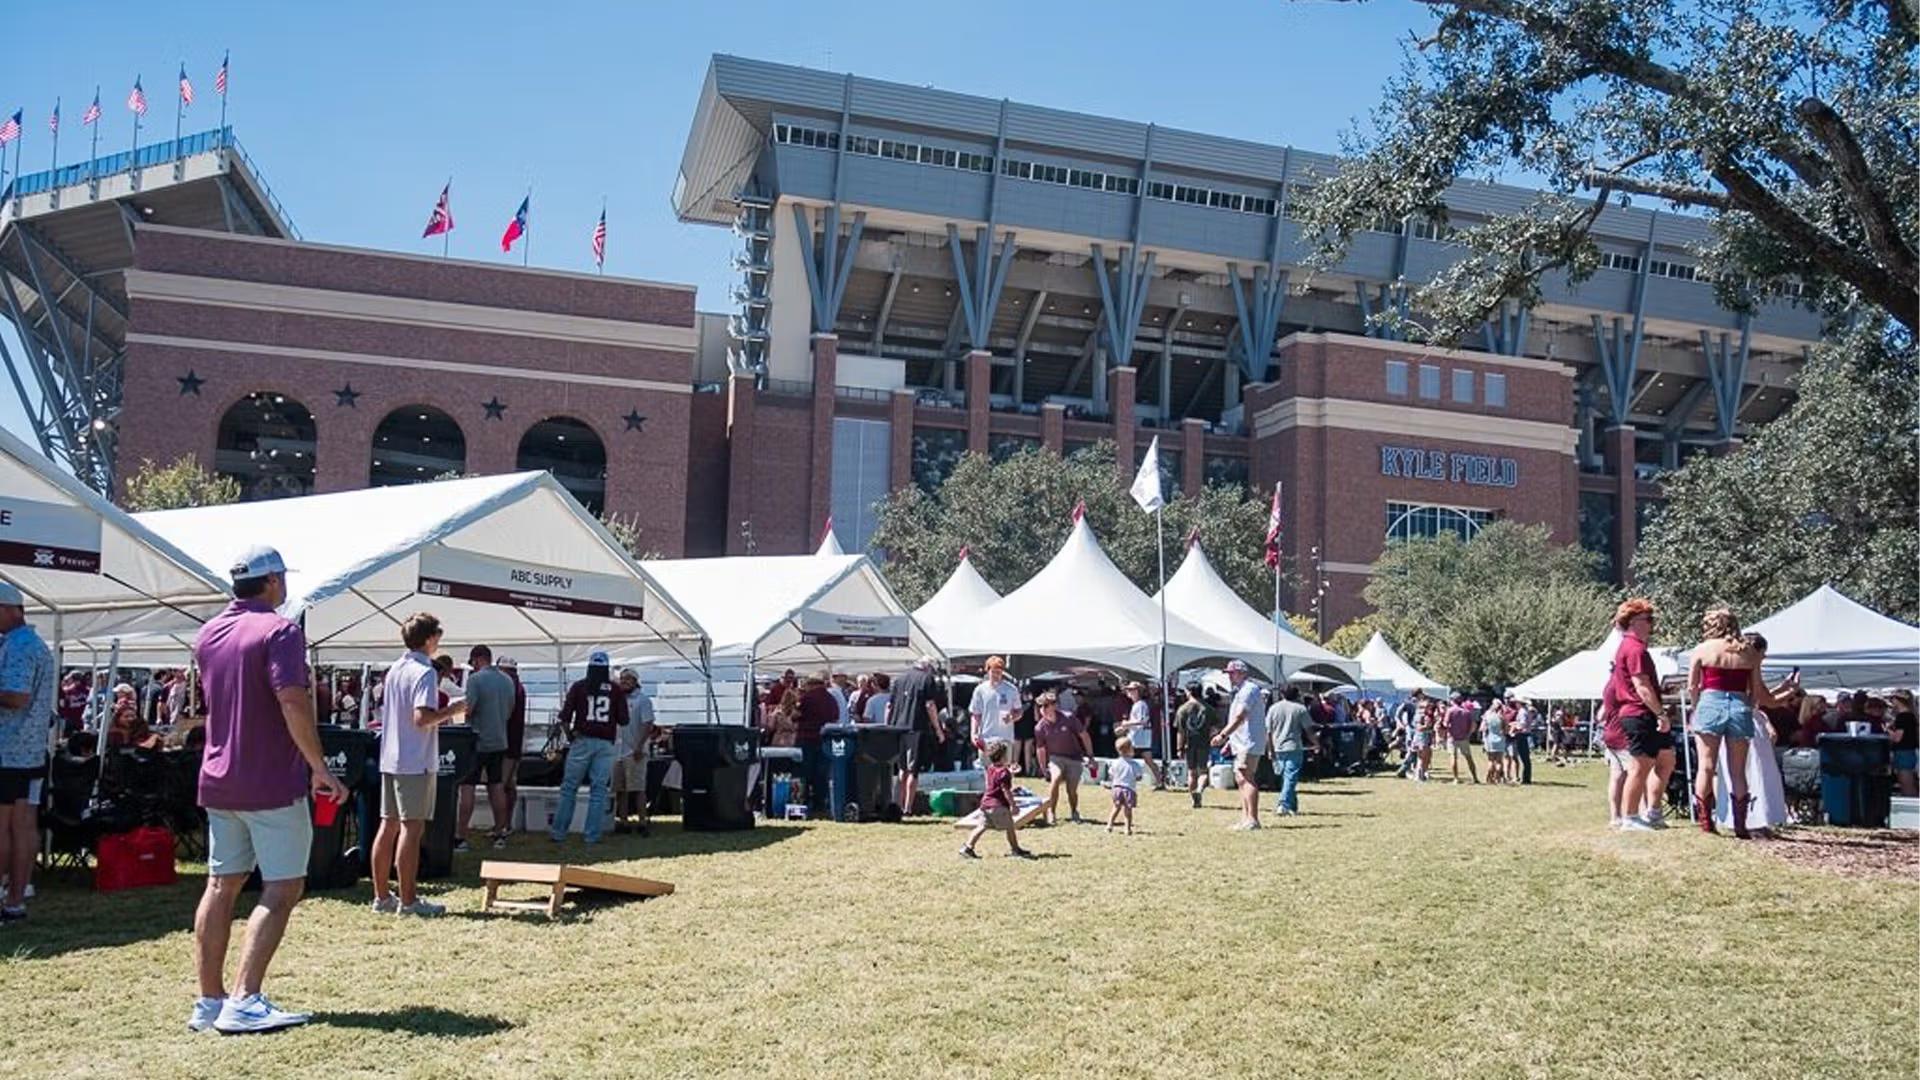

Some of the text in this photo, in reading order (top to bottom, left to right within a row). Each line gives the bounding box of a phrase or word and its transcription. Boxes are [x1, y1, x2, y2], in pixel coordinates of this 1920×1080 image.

[1382, 446, 1518, 488] KYLE FIELD
[510, 569, 573, 589] ABC SUPPLY
[586, 695, 610, 722] 12
